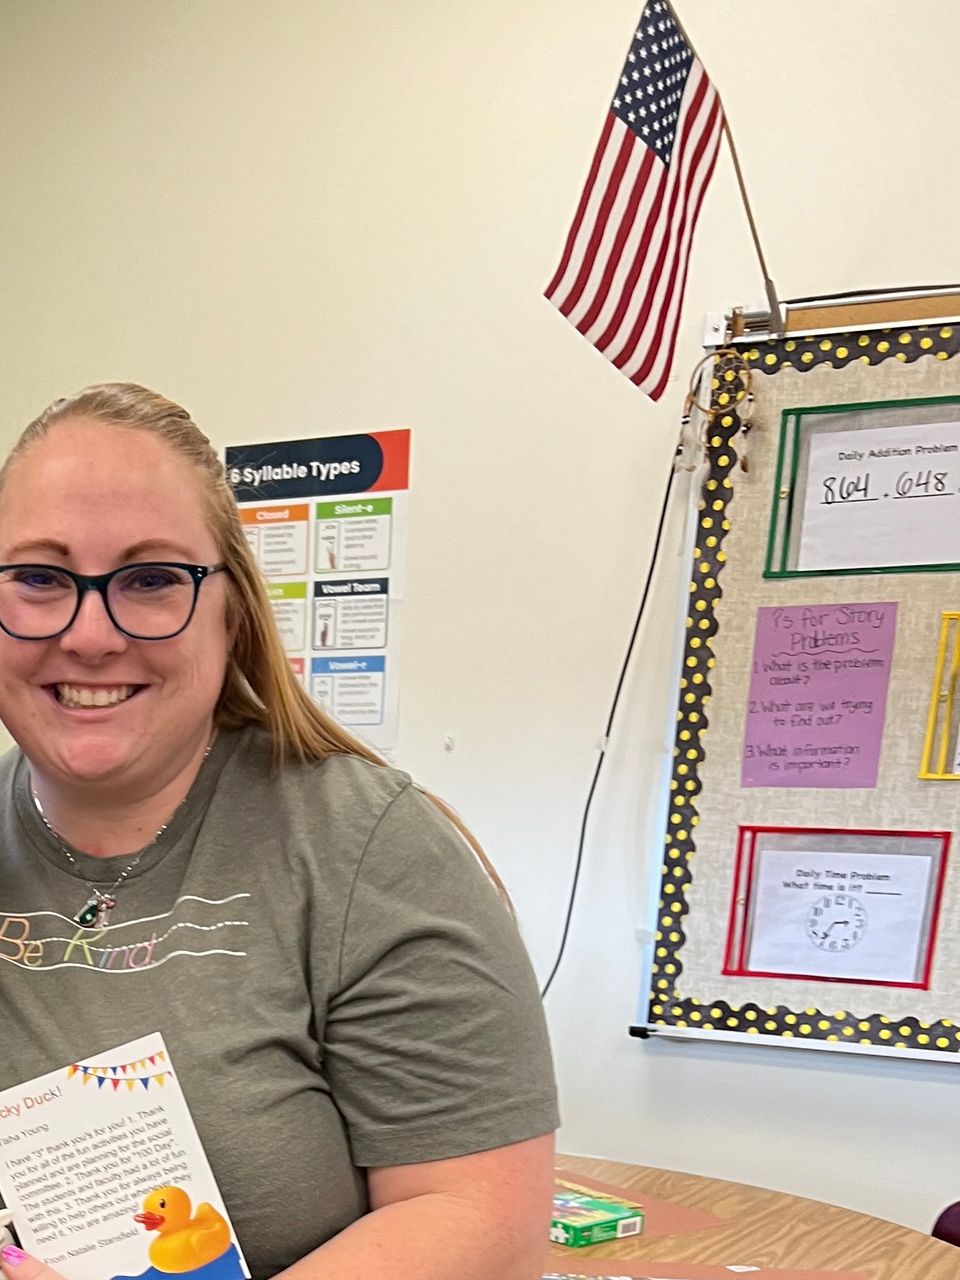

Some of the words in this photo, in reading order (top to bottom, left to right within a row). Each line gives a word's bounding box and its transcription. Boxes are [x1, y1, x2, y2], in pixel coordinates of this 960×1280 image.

[838, 452, 864, 461] Daily
[867, 448, 912, 459] Addition
[915, 444, 958, 454] Problem
[230, 469, 241, 483] 6
[243, 463, 308, 486] Syllable
[309, 460, 361, 481] Types
[822, 473, 870, 504] 864
[896, 470, 948, 497] 648
[321, 583, 351, 594] Vowel
[353, 582, 381, 592] Team
[802, 607, 829, 628] for
[837, 606, 885, 628] Story
[790, 630, 861, 650] Problems
[798, 661, 808, 672] is
[762, 700, 792, 713] What
[796, 869, 821, 880] Daily
[825, 870, 847, 879] Time
[850, 871, 890, 881] Problem
[63, 927, 157, 969] Kind
[22, 1085, 62, 1108] Duck!
[9, 1153, 32, 1167] have
[45, 1139, 70, 1154] thank
[93, 1126, 106, 1136] for
[136, 1103, 166, 1120] Thank
[20, 1122, 49, 1139] Young
[8, 1169, 26, 1181] you
[26, 1164, 38, 1175] for
[38, 1159, 50, 1169] all
[50, 1155, 61, 1165] of
[60, 1150, 75, 1161] the
[75, 1144, 91, 1156] fun
[90, 1131, 128, 1150] activities
[128, 1125, 146, 1138] you
[145, 1115, 168, 1130] have
[13, 1172, 48, 1192] planned
[48, 1166, 65, 1178] and
[65, 1161, 80, 1172] are
[80, 1148, 118, 1167] planning
[117, 1143, 130, 1153] for
[131, 1137, 146, 1148] the
[145, 1127, 172, 1142] social
[21, 1199, 40, 1212] The
[40, 1187, 76, 1206] students
[76, 1181, 93, 1193] and
[93, 1171, 122, 1187] faculty
[123, 1164, 140, 1176] had
[148, 1157, 160, 1167] lot
[160, 1153, 170, 1163] of
[170, 1147, 186, 1159] fun
[73, 1165, 101, 1181] Thank
[101, 1159, 120, 1172] you
[118, 1153, 132, 1165] for
[27, 1211, 45, 1223] with
[73, 1190, 103, 1206] Thank
[101, 1186, 119, 1199] you
[118, 1180, 131, 1190] for
[131, 1169, 162, 1186] always
[162, 1160, 188, 1176] being
[30, 1219, 58, 1235] willing
[57, 1215, 68, 1224] to
[67, 1208, 87, 1222] help
[86, 1199, 114, 1214] others
[113, 1193, 130, 1205] out
[171, 1171, 193, 1185] they
[35, 1231, 57, 1245] need
[65, 1221, 85, 1234] You
[85, 1216, 100, 1227] are
